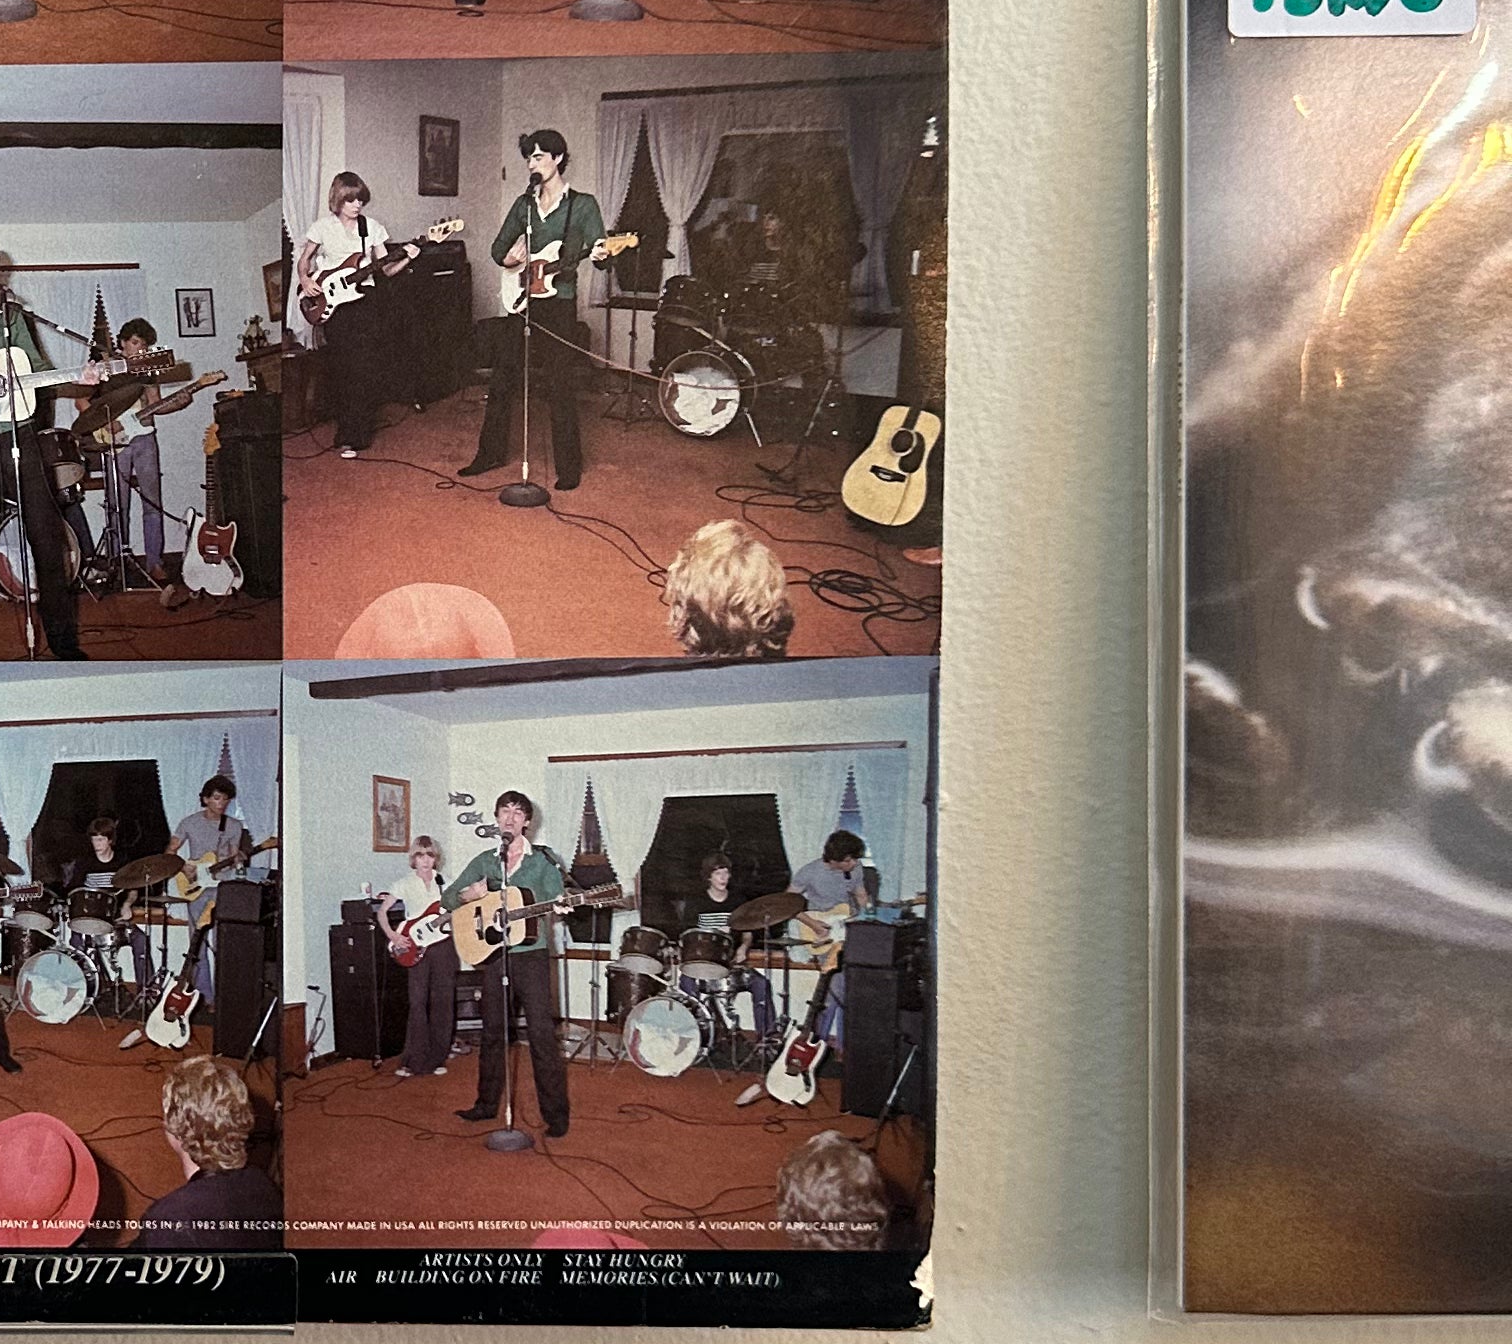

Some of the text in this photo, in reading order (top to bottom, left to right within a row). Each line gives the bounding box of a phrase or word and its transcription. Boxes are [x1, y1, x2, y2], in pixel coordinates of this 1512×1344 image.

[42, 1219, 85, 1229] TALKING
[89, 1219, 121, 1229] HEADS
[125, 1219, 157, 1229] TOURS
[192, 1220, 216, 1230] 1982
[219, 1220, 240, 1230] SIRE
[243, 1220, 289, 1230] RECORDS
[293, 1220, 344, 1230] COMPANY
[347, 1220, 376, 1230] MADE
[380, 1220, 391, 1230] IN
[395, 1220, 416, 1230] USA
[418, 1220, 435, 1230] ALL
[438, 1220, 474, 1230] RIGHTS
[478, 1220, 527, 1230] RESERVED
[530, 1220, 612, 1230] UNAUTHORIZED
[615, 1220, 683, 1230] DUPLICATION
[686, 1220, 695, 1230] IS
[698, 1220, 706, 1230] A
[709, 1220, 765, 1230] VIOLATION
[768, 1220, 782, 1230] OF
[785, 1220, 844, 1231] APPLICABLE
[420, 1253, 686, 1268] ARTISTS ONLY STAY HUNGRY
[35, 1254, 226, 1291] (1977-1979)
[326, 1270, 781, 1288] AIR BUILDING ON FIRE MEMORIES (CAN'T WAIT)
